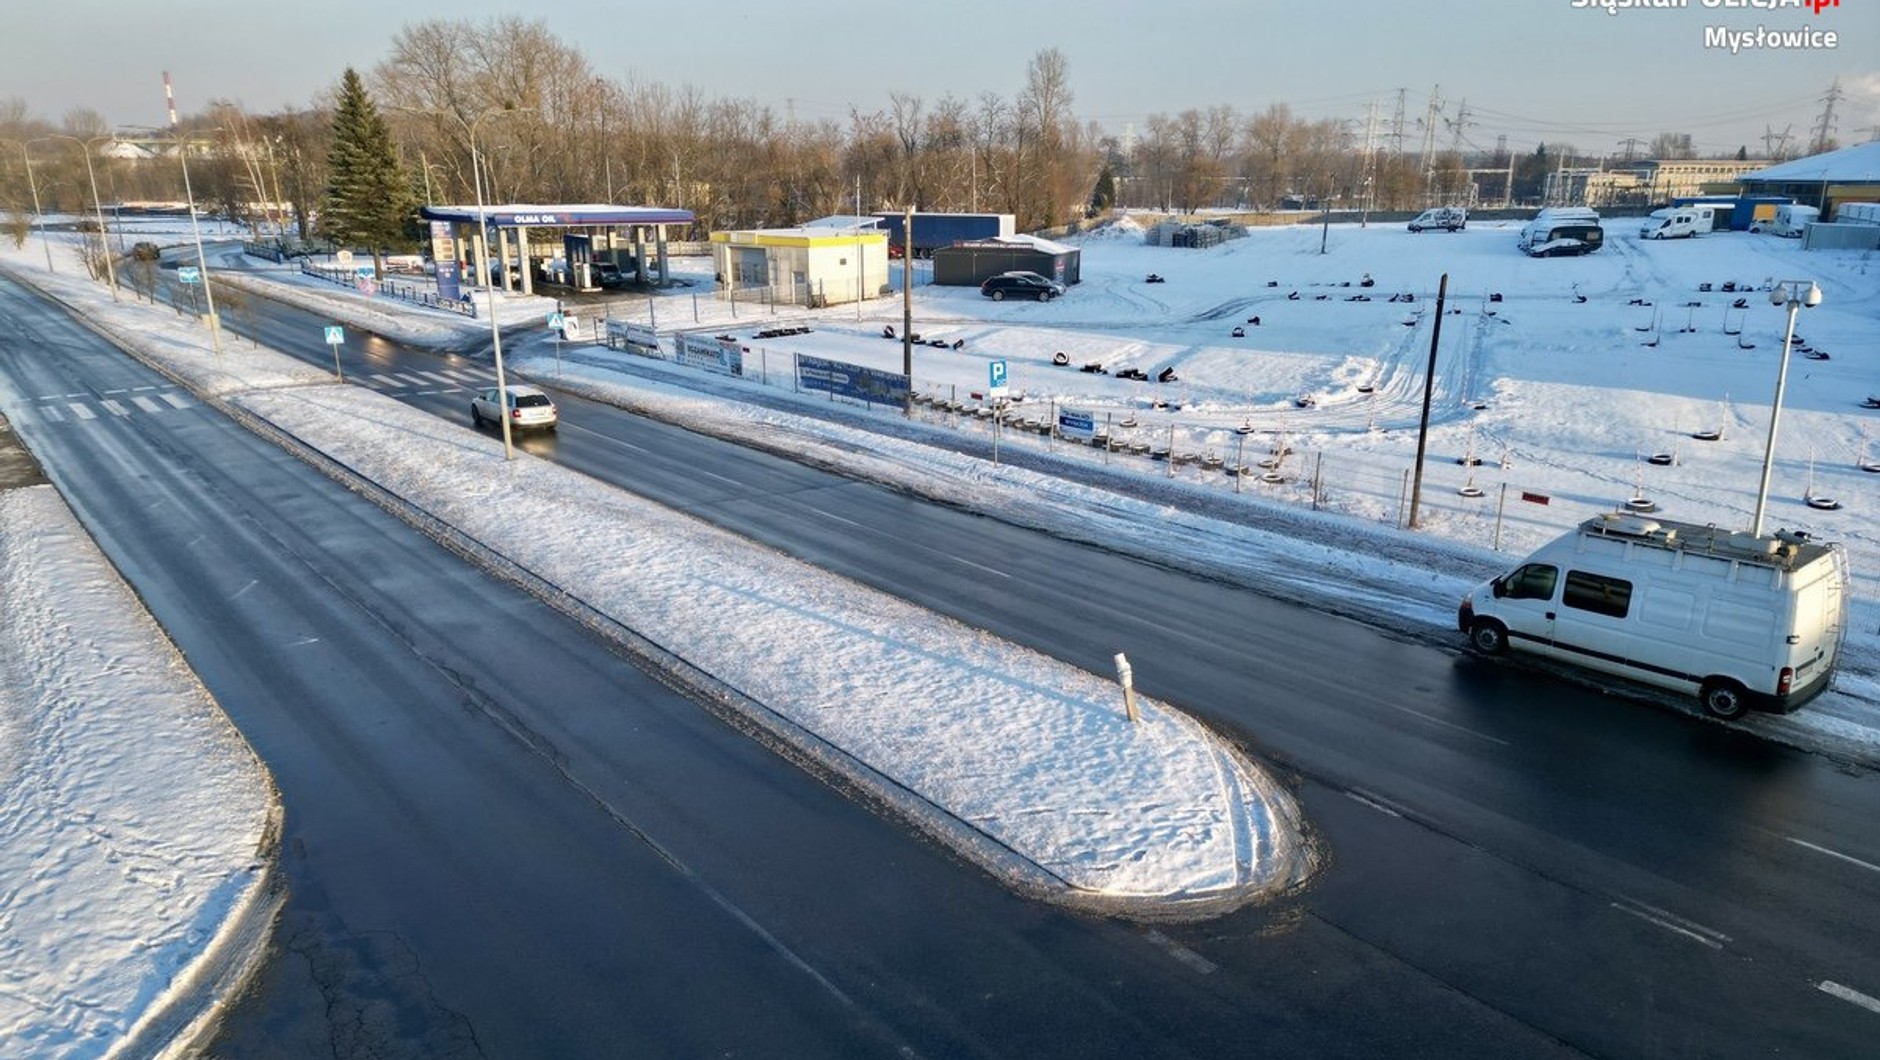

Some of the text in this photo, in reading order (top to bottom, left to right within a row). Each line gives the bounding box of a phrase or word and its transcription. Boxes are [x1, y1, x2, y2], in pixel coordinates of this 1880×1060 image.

[514, 214, 556, 224] OLMA OIL
[993, 363, 1004, 380] P
